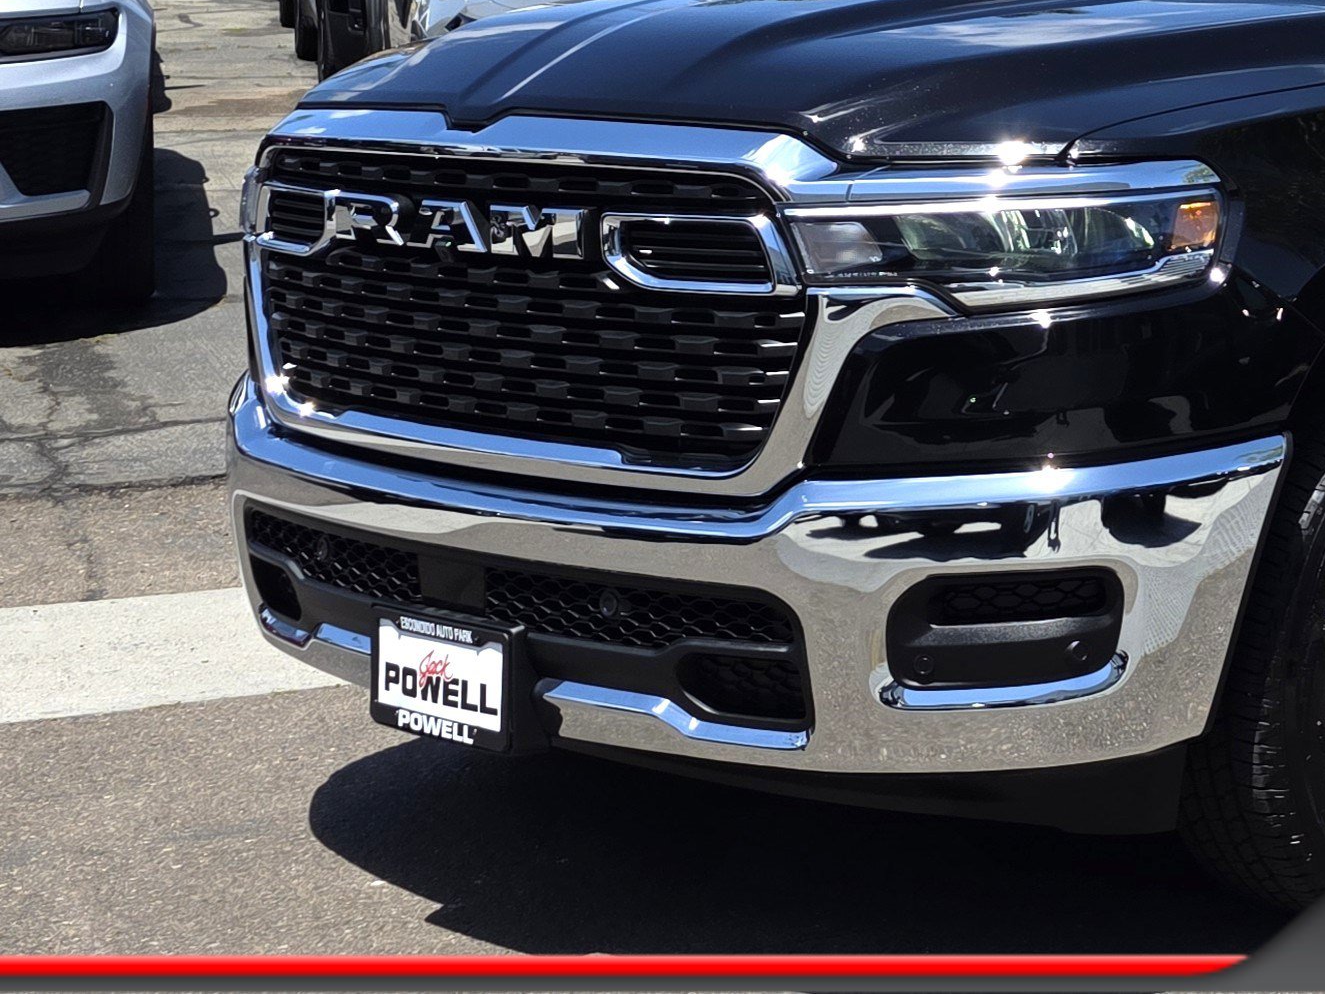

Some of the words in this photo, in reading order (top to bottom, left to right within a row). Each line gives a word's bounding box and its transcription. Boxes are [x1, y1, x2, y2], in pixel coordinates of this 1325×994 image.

[326, 189, 590, 260] RAM
[400, 615, 435, 636] ESCONDIDO
[436, 624, 453, 640] AUTO
[453, 628, 473, 644] PARK
[419, 649, 454, 688] Jack
[384, 661, 498, 716] POWELL
[397, 709, 475, 745] POWELL
